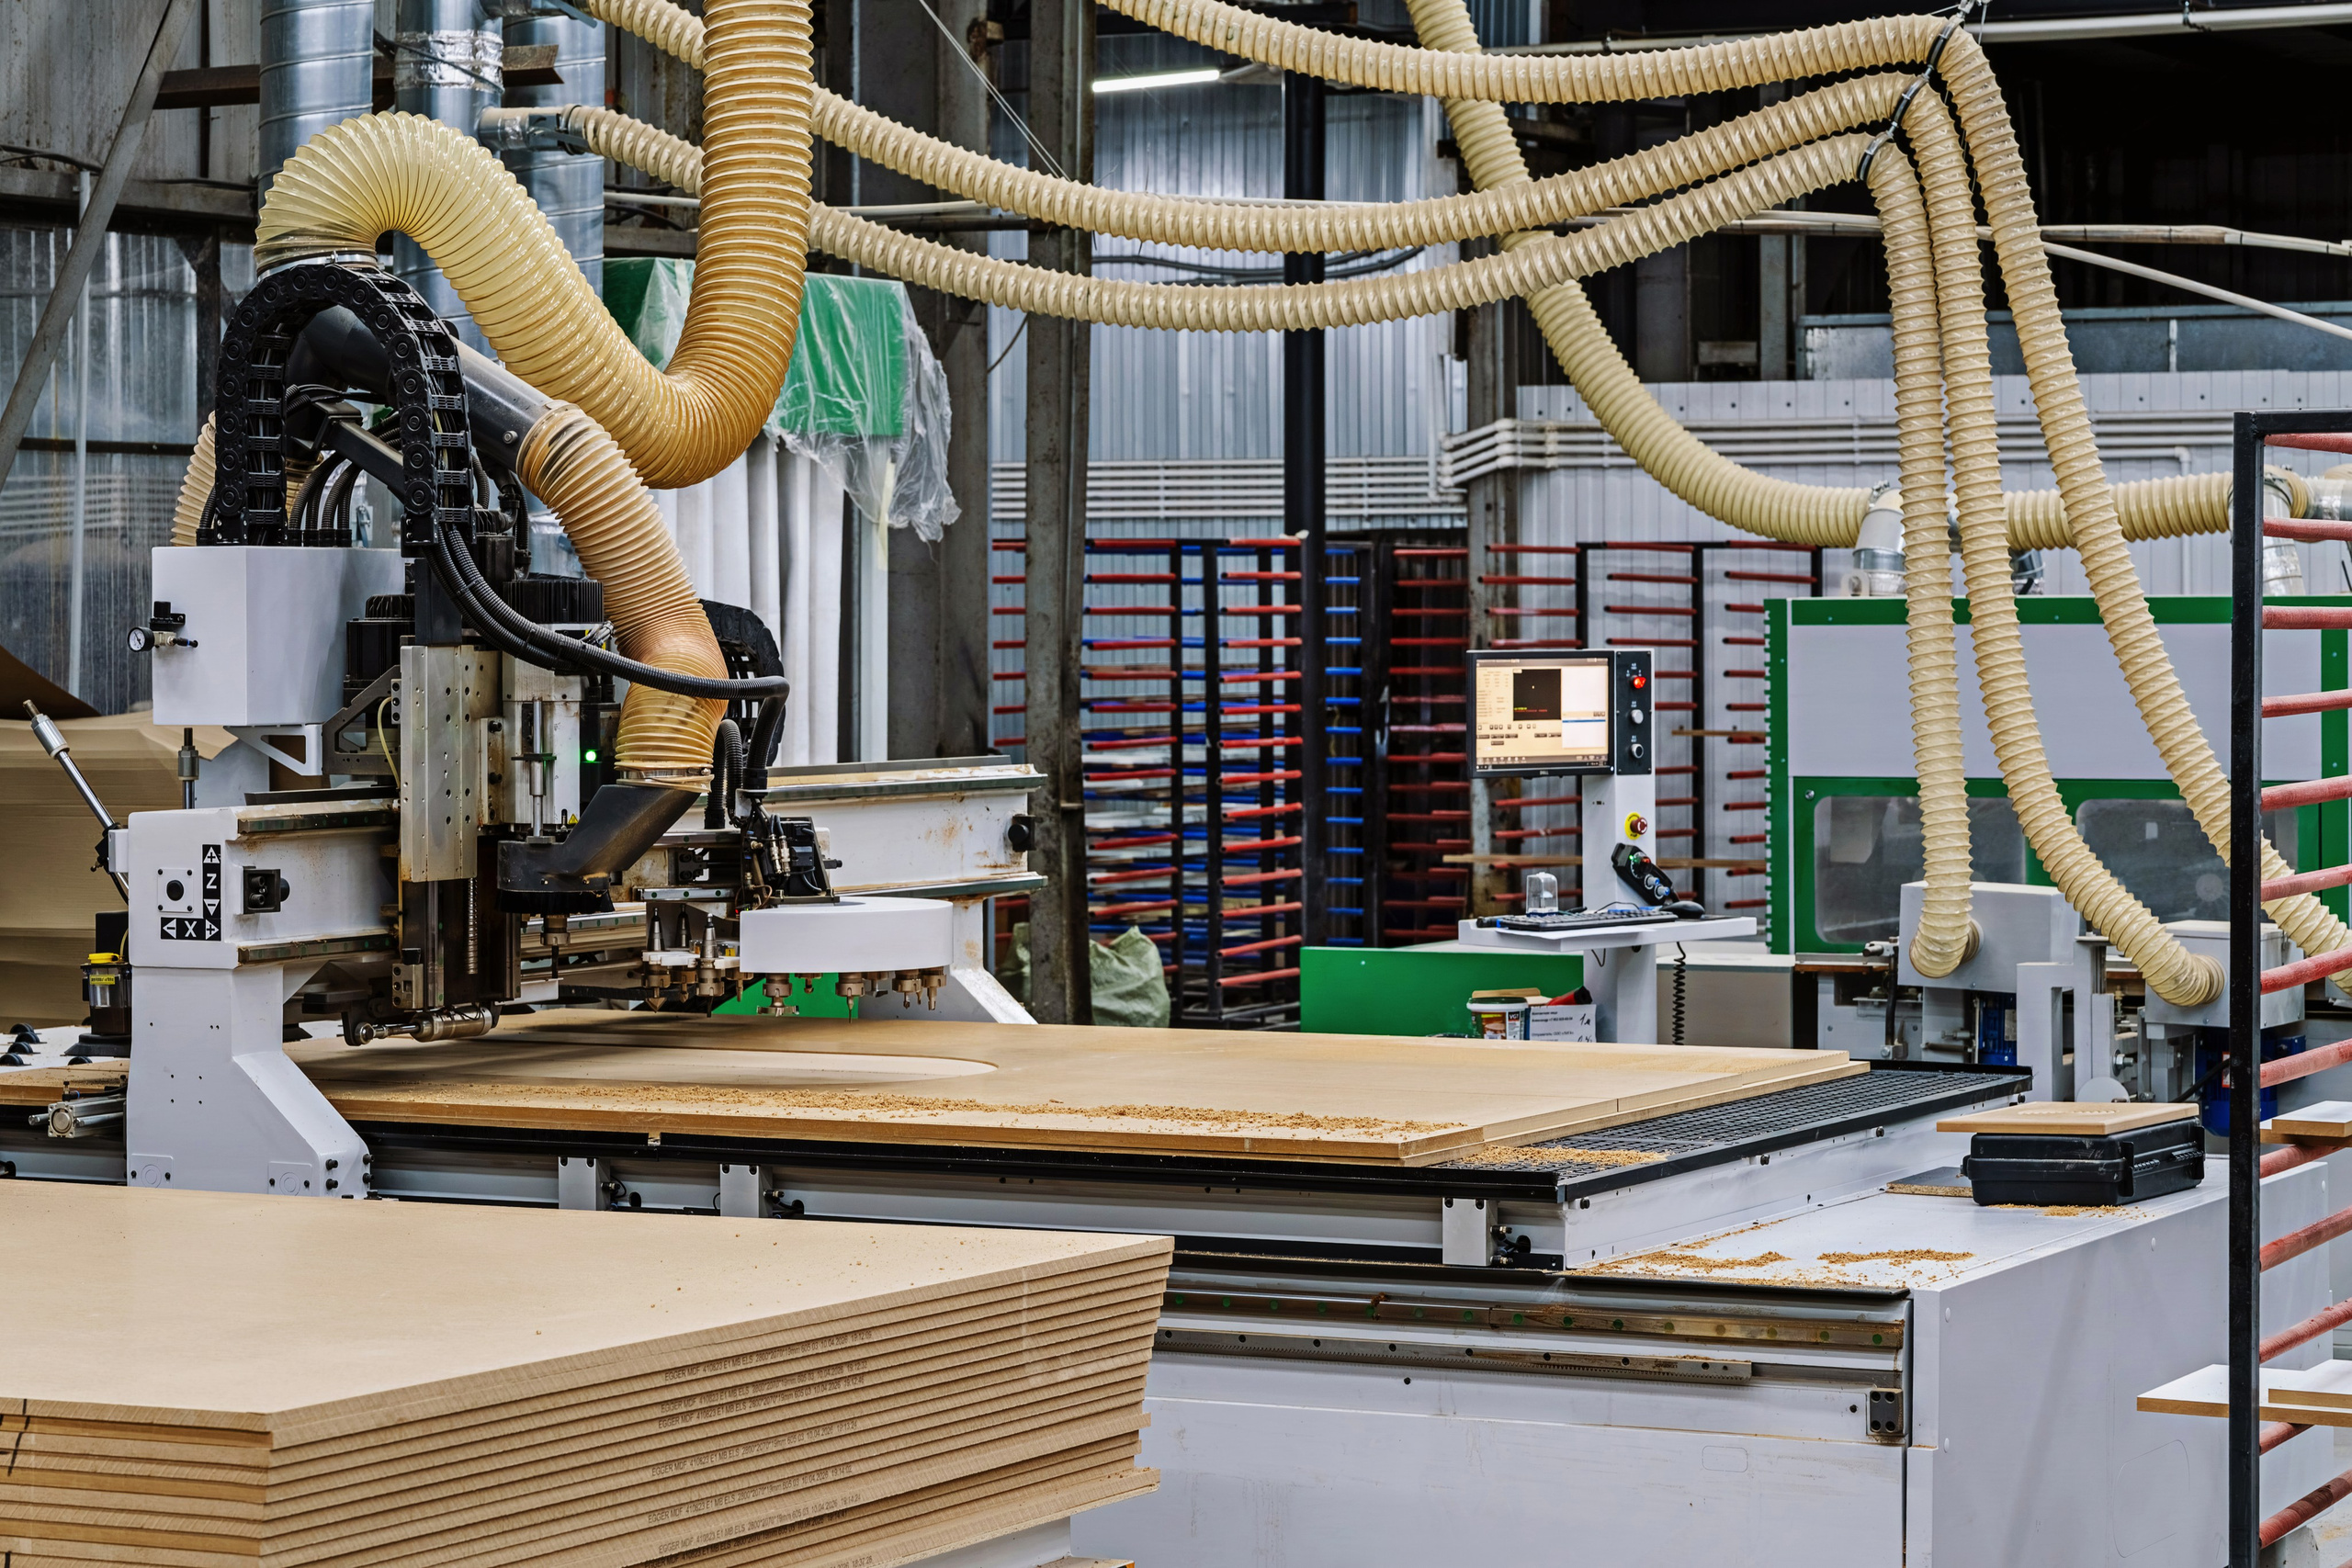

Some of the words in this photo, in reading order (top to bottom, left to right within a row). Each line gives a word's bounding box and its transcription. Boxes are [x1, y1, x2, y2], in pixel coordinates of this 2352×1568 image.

[206, 873, 217, 889] Z
[184, 920, 198, 938] X
[665, 1369, 686, 1382] EGGER
[659, 1416, 680, 1428] EGGER
[652, 1464, 673, 1476] EGGER
[649, 1510, 669, 1523] EGGER
[659, 1540, 680, 1553] EGGER
